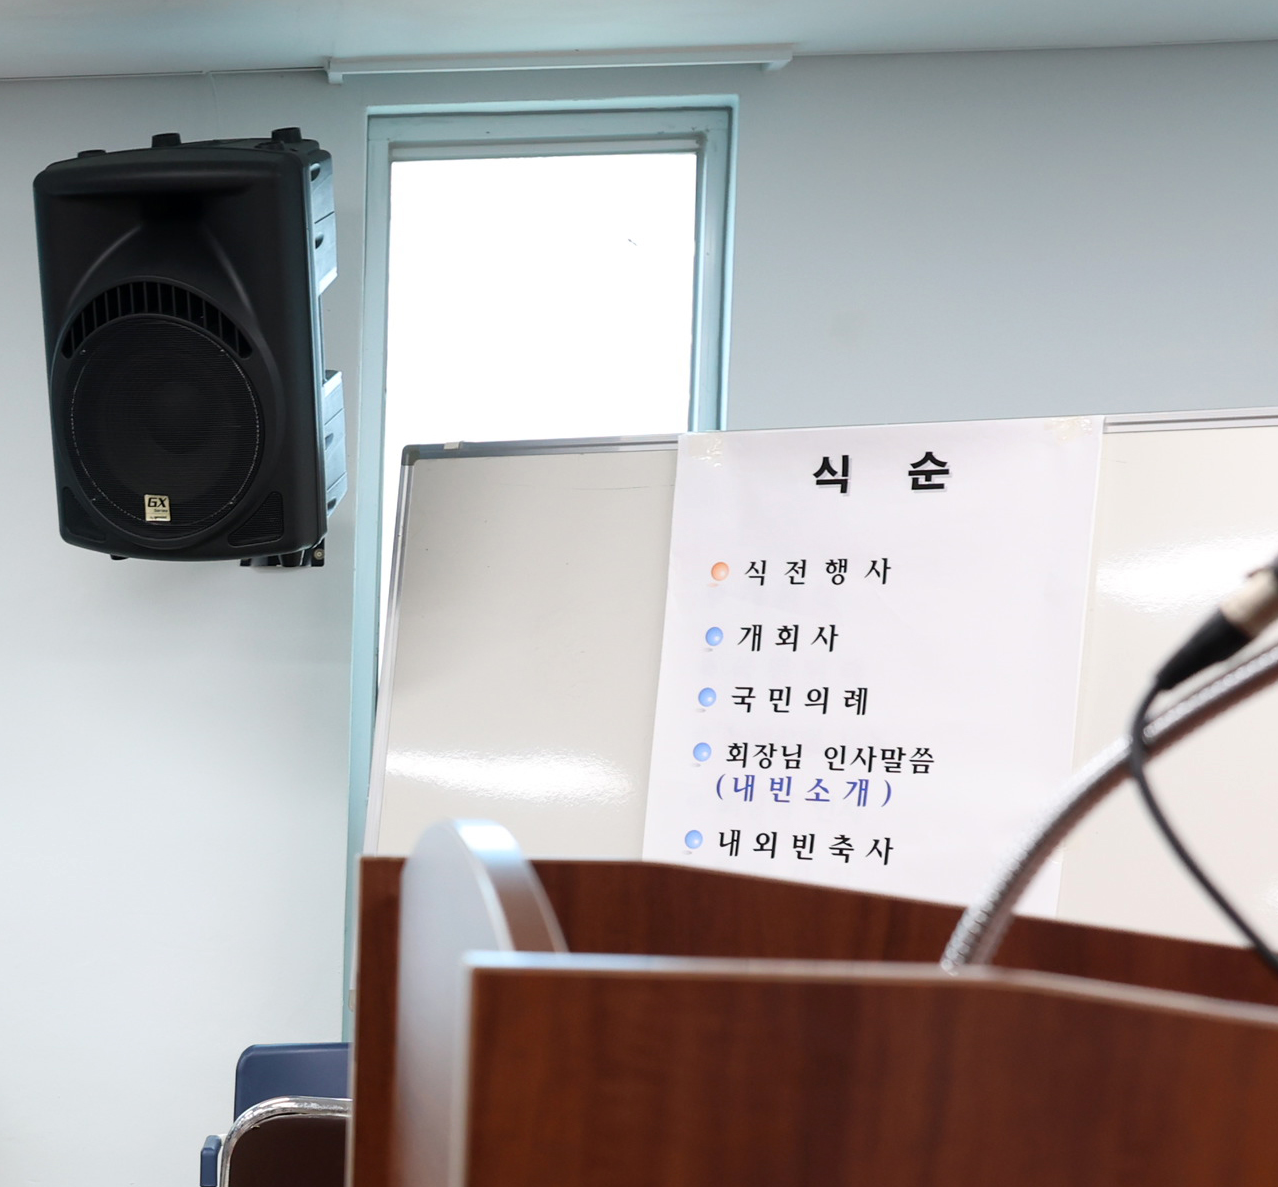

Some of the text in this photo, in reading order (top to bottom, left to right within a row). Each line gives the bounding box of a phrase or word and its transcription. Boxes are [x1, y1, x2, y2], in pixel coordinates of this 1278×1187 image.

[148, 497, 166, 507] GX
[727, 743, 934, 774] 회장님 인사말씀
